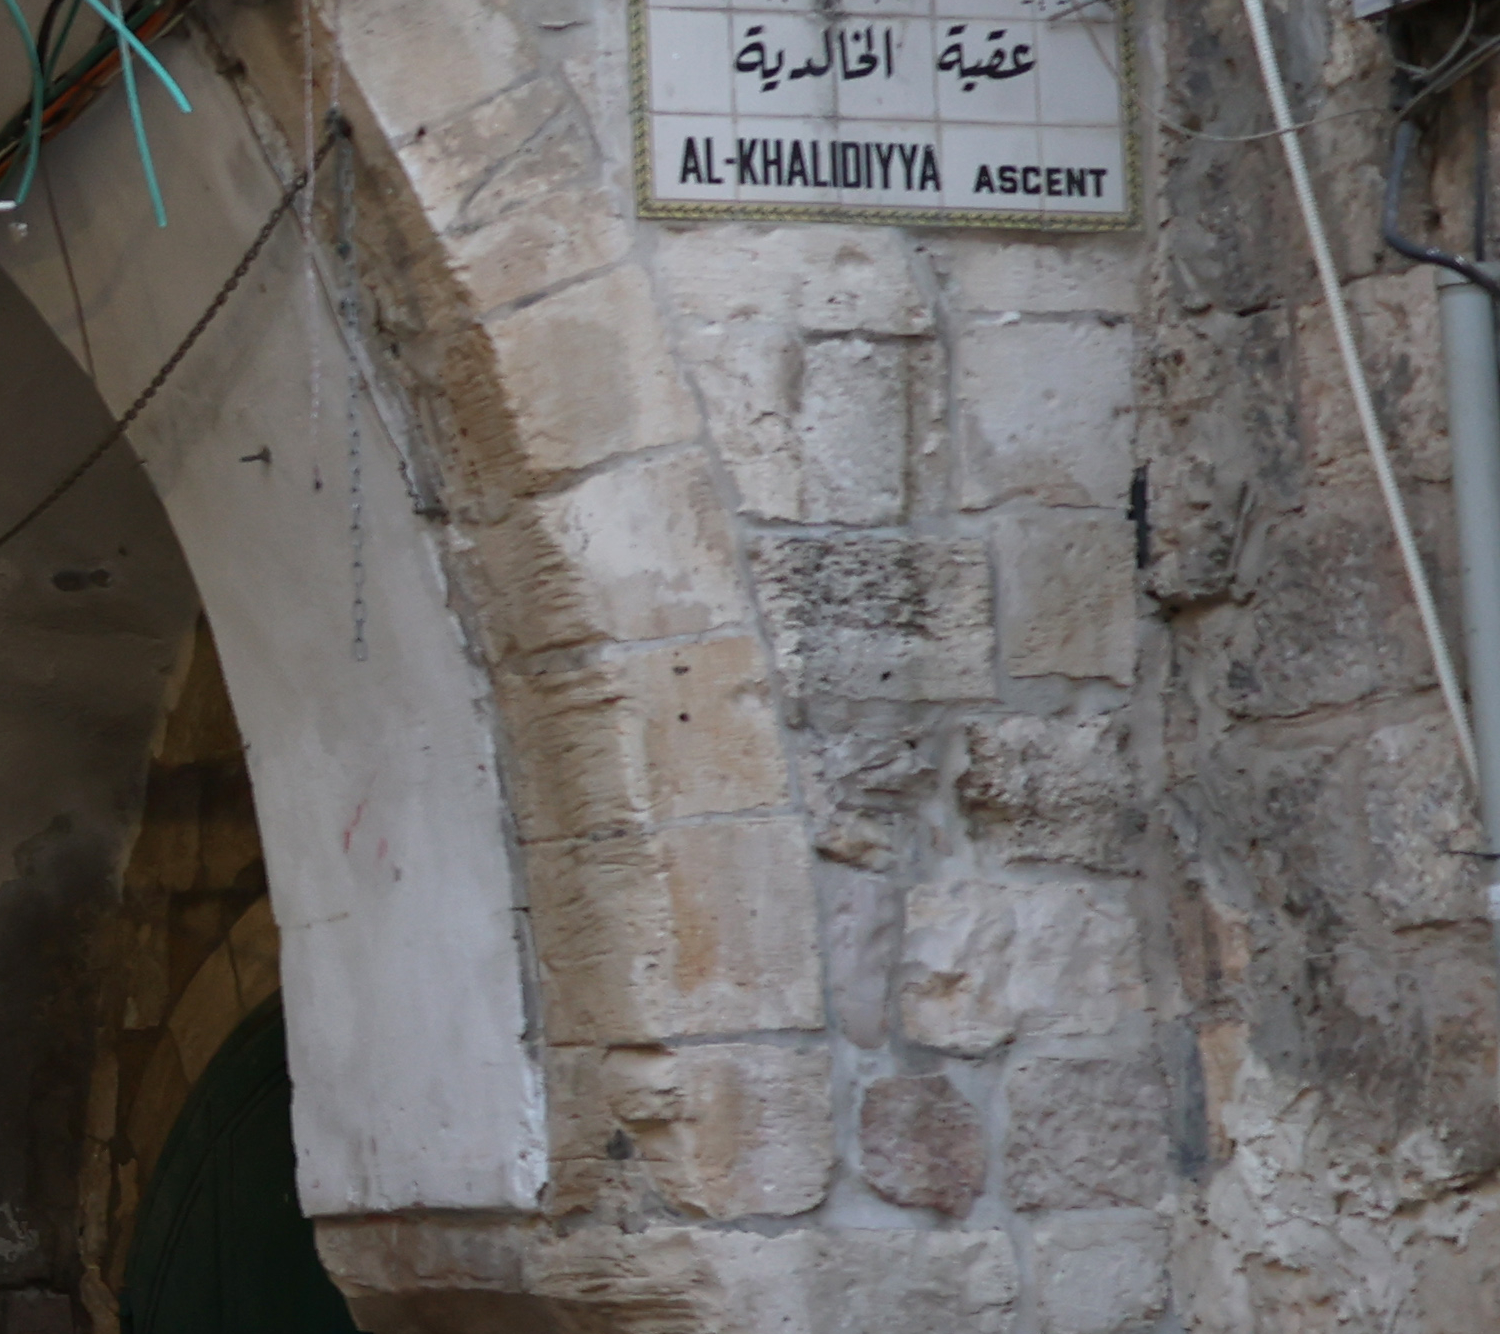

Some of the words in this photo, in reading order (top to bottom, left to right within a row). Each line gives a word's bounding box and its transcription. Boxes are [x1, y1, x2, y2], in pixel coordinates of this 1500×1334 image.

[735, 24, 895, 92] الخالدية
[936, 24, 1037, 92] عقبة
[679, 136, 942, 192] AL-KHALIDIYYA
[974, 165, 1108, 198] ASCENT
